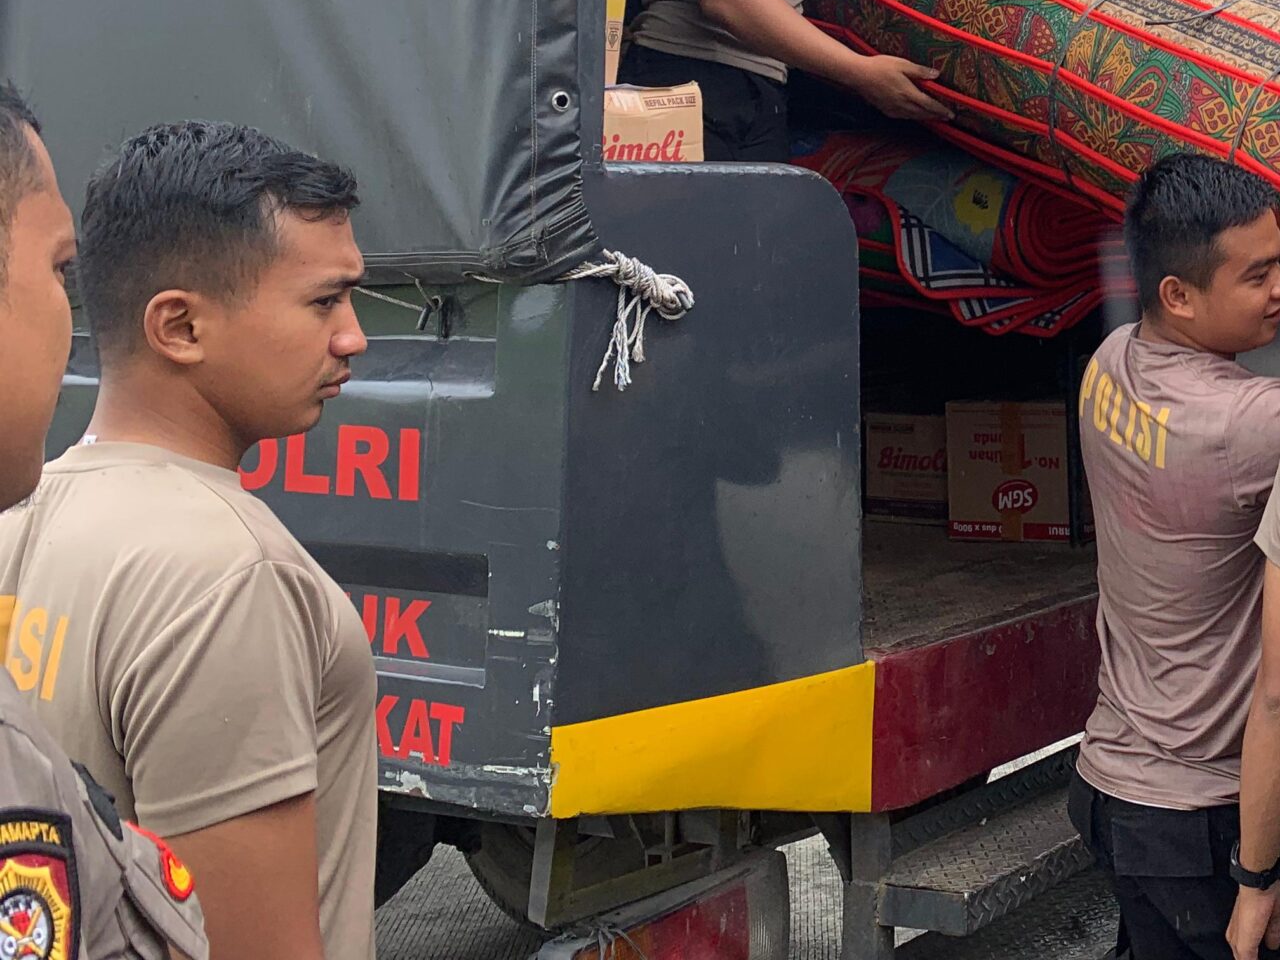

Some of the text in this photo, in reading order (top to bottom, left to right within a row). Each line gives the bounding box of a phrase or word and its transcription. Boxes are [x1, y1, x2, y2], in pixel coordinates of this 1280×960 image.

[667, 97, 684, 106] PACK
[603, 129, 686, 161] imoli
[1079, 359, 1171, 469] POLISI
[237, 424, 421, 501] OLRI
[998, 487, 1033, 510] SGM
[375, 695, 465, 767] KAT
[0, 821, 61, 845] AMAPTA
